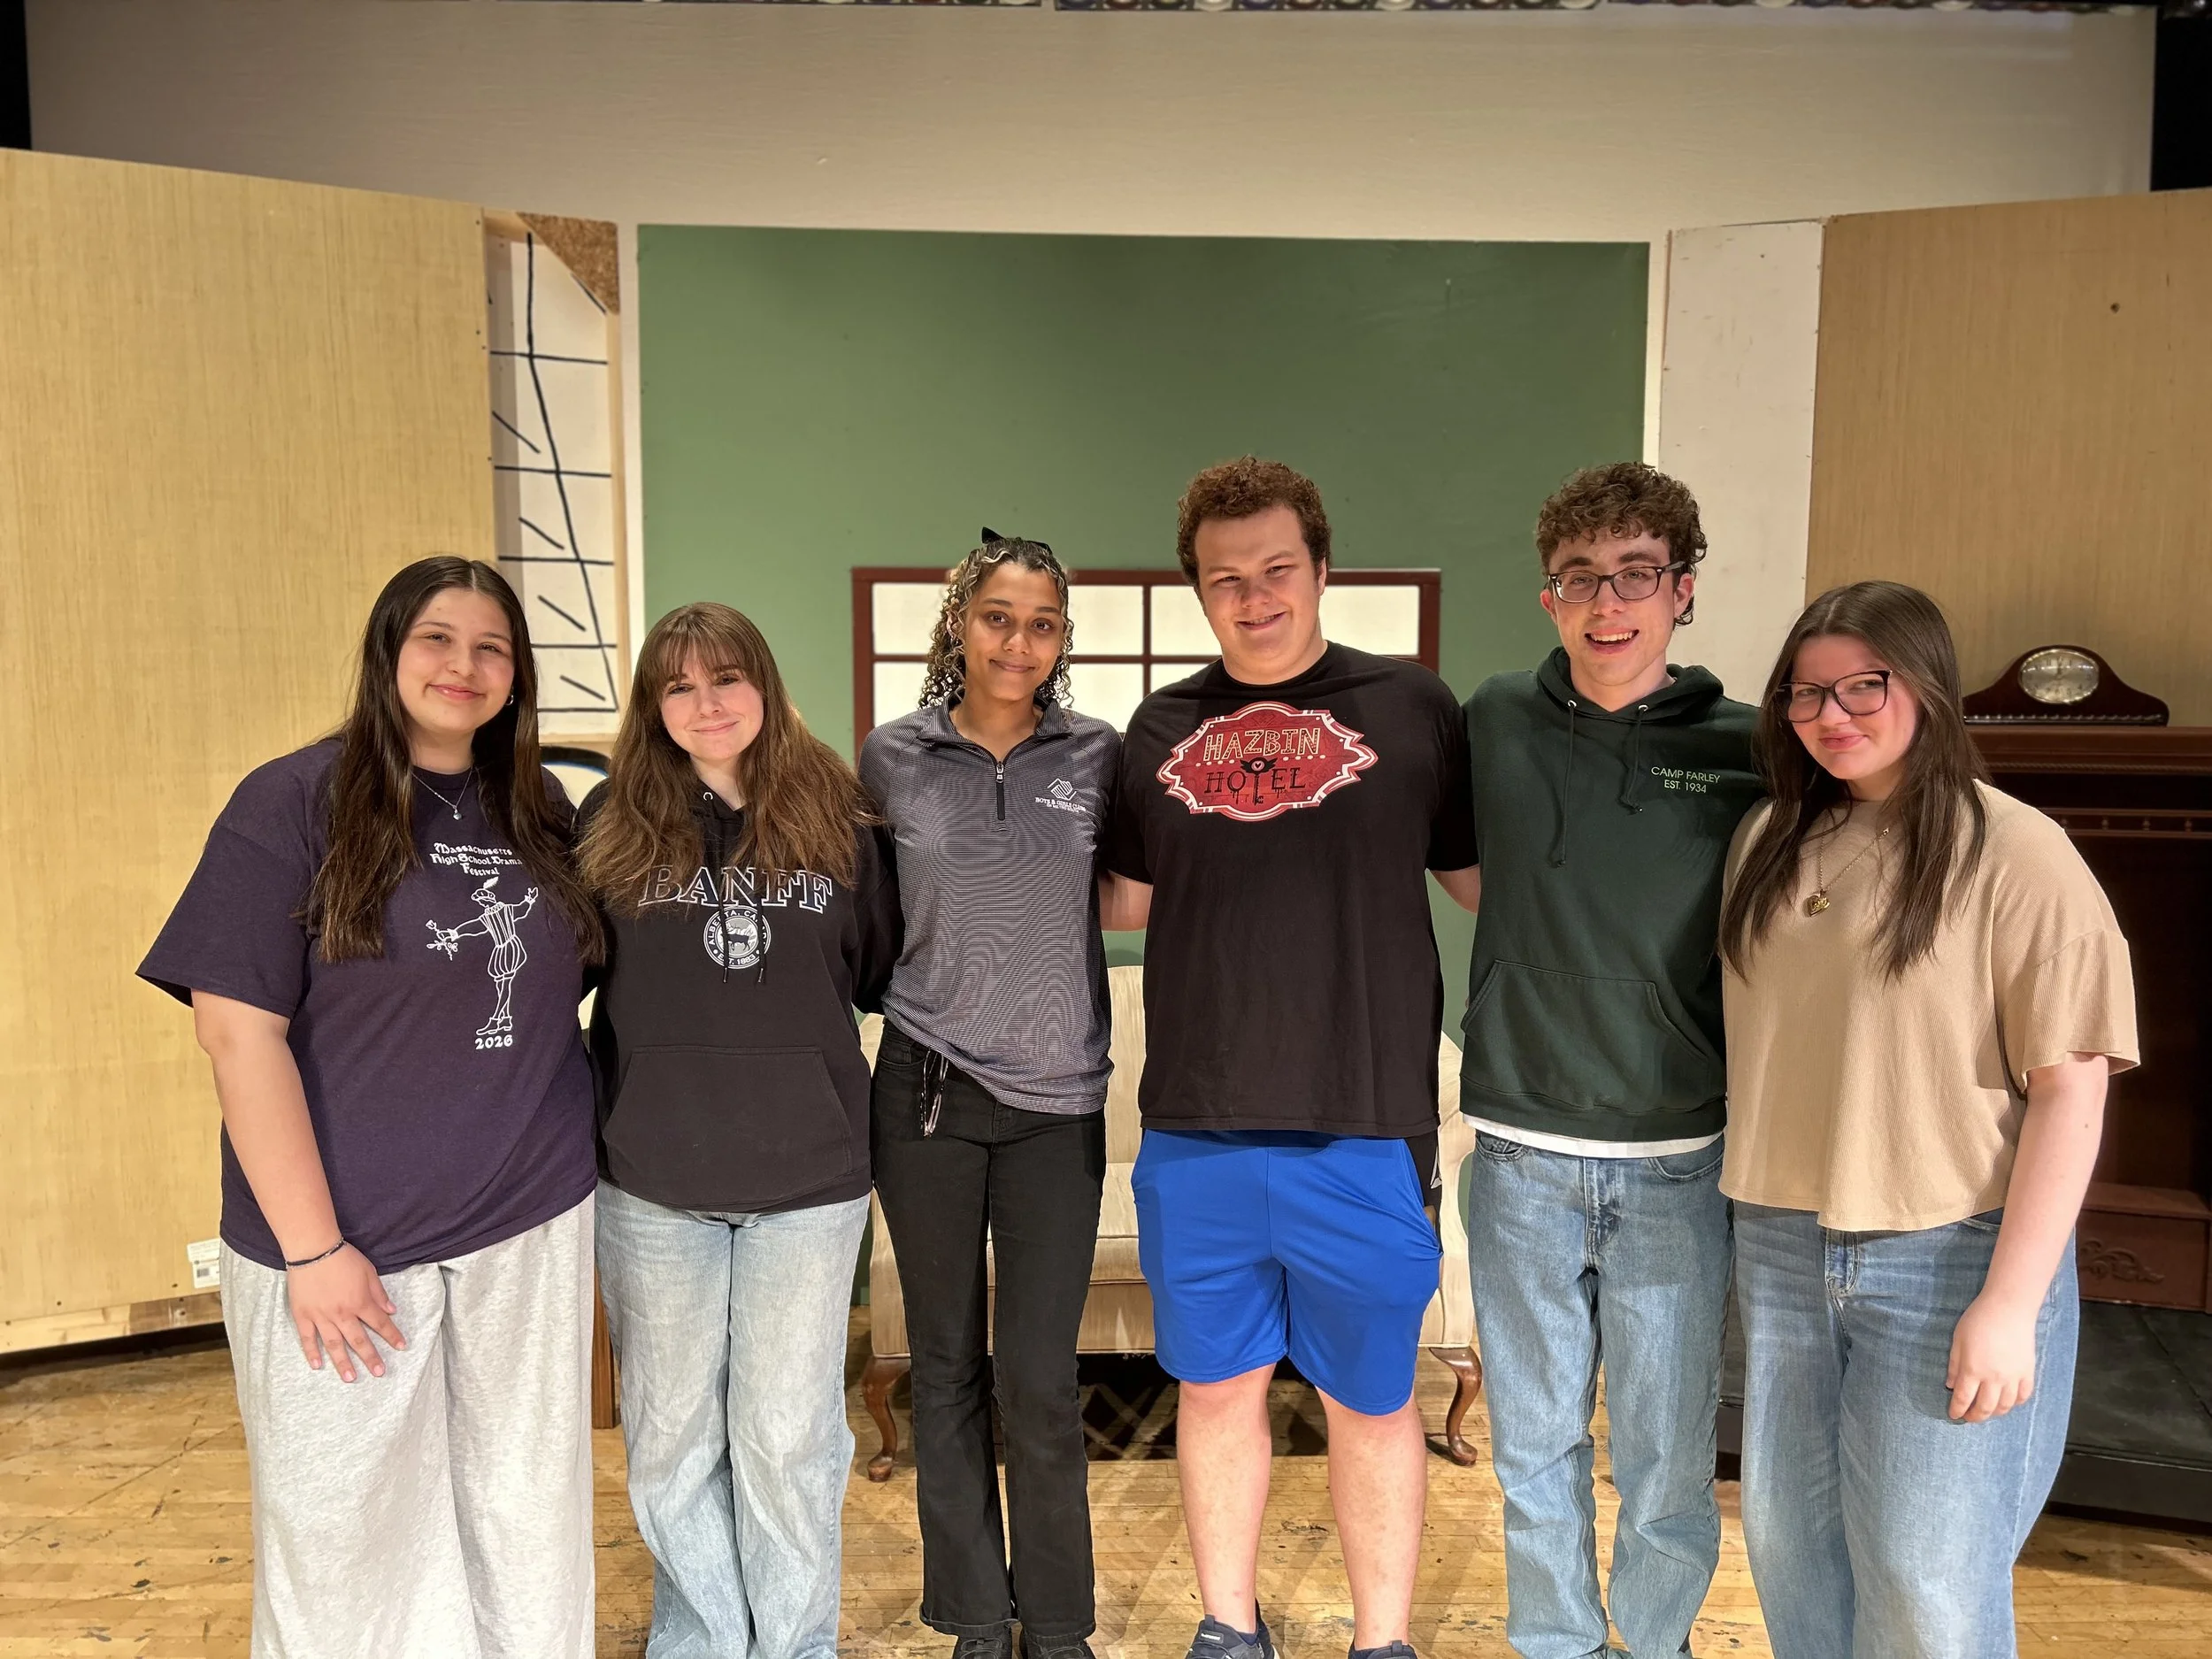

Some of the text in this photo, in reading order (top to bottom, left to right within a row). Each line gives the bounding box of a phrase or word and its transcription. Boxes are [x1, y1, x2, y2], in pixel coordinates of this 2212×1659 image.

[1203, 728, 1320, 761] HAZBIN
[1651, 766, 1721, 783] CAMP FARLEY
[1204, 763, 1306, 803] HOTEL
[1664, 780, 1707, 793] EST. 1934
[434, 842, 512, 855] Massachusetts
[491, 856, 522, 864] Drama
[460, 863, 500, 876] Festival
[637, 864, 833, 914] BANFF
[718, 953, 734, 964] ET.
[474, 1034, 513, 1050] 2026
